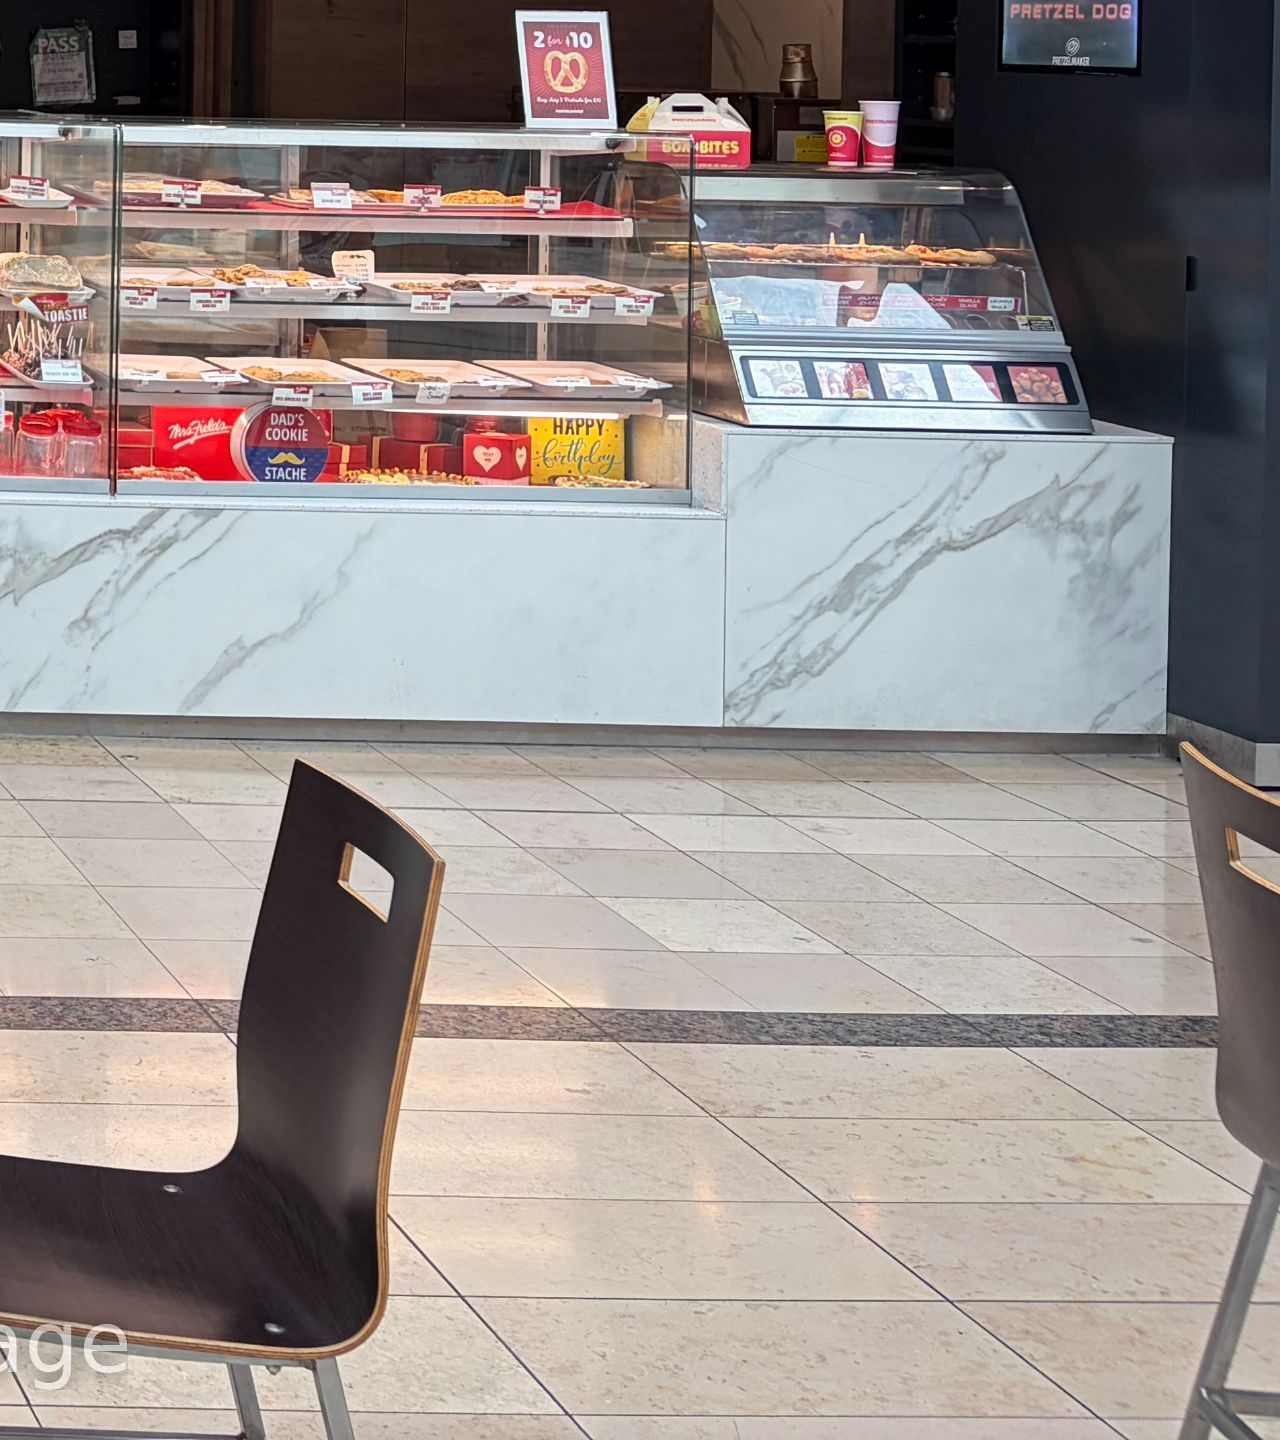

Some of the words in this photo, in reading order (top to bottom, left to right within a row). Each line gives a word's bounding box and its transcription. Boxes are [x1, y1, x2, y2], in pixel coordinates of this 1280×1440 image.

[1010, 3, 1084, 19] PRETZEL
[1092, 3, 1132, 19] DOG
[39, 36, 80, 53] PASS
[533, 31, 545, 48] 2
[547, 35, 564, 48] for
[699, 140, 740, 154] BITES
[270, 412, 305, 427] DAD'S
[553, 417, 605, 436] HAPPY
[265, 427, 309, 443] COOKIE
[265, 465, 308, 482] STACHE
